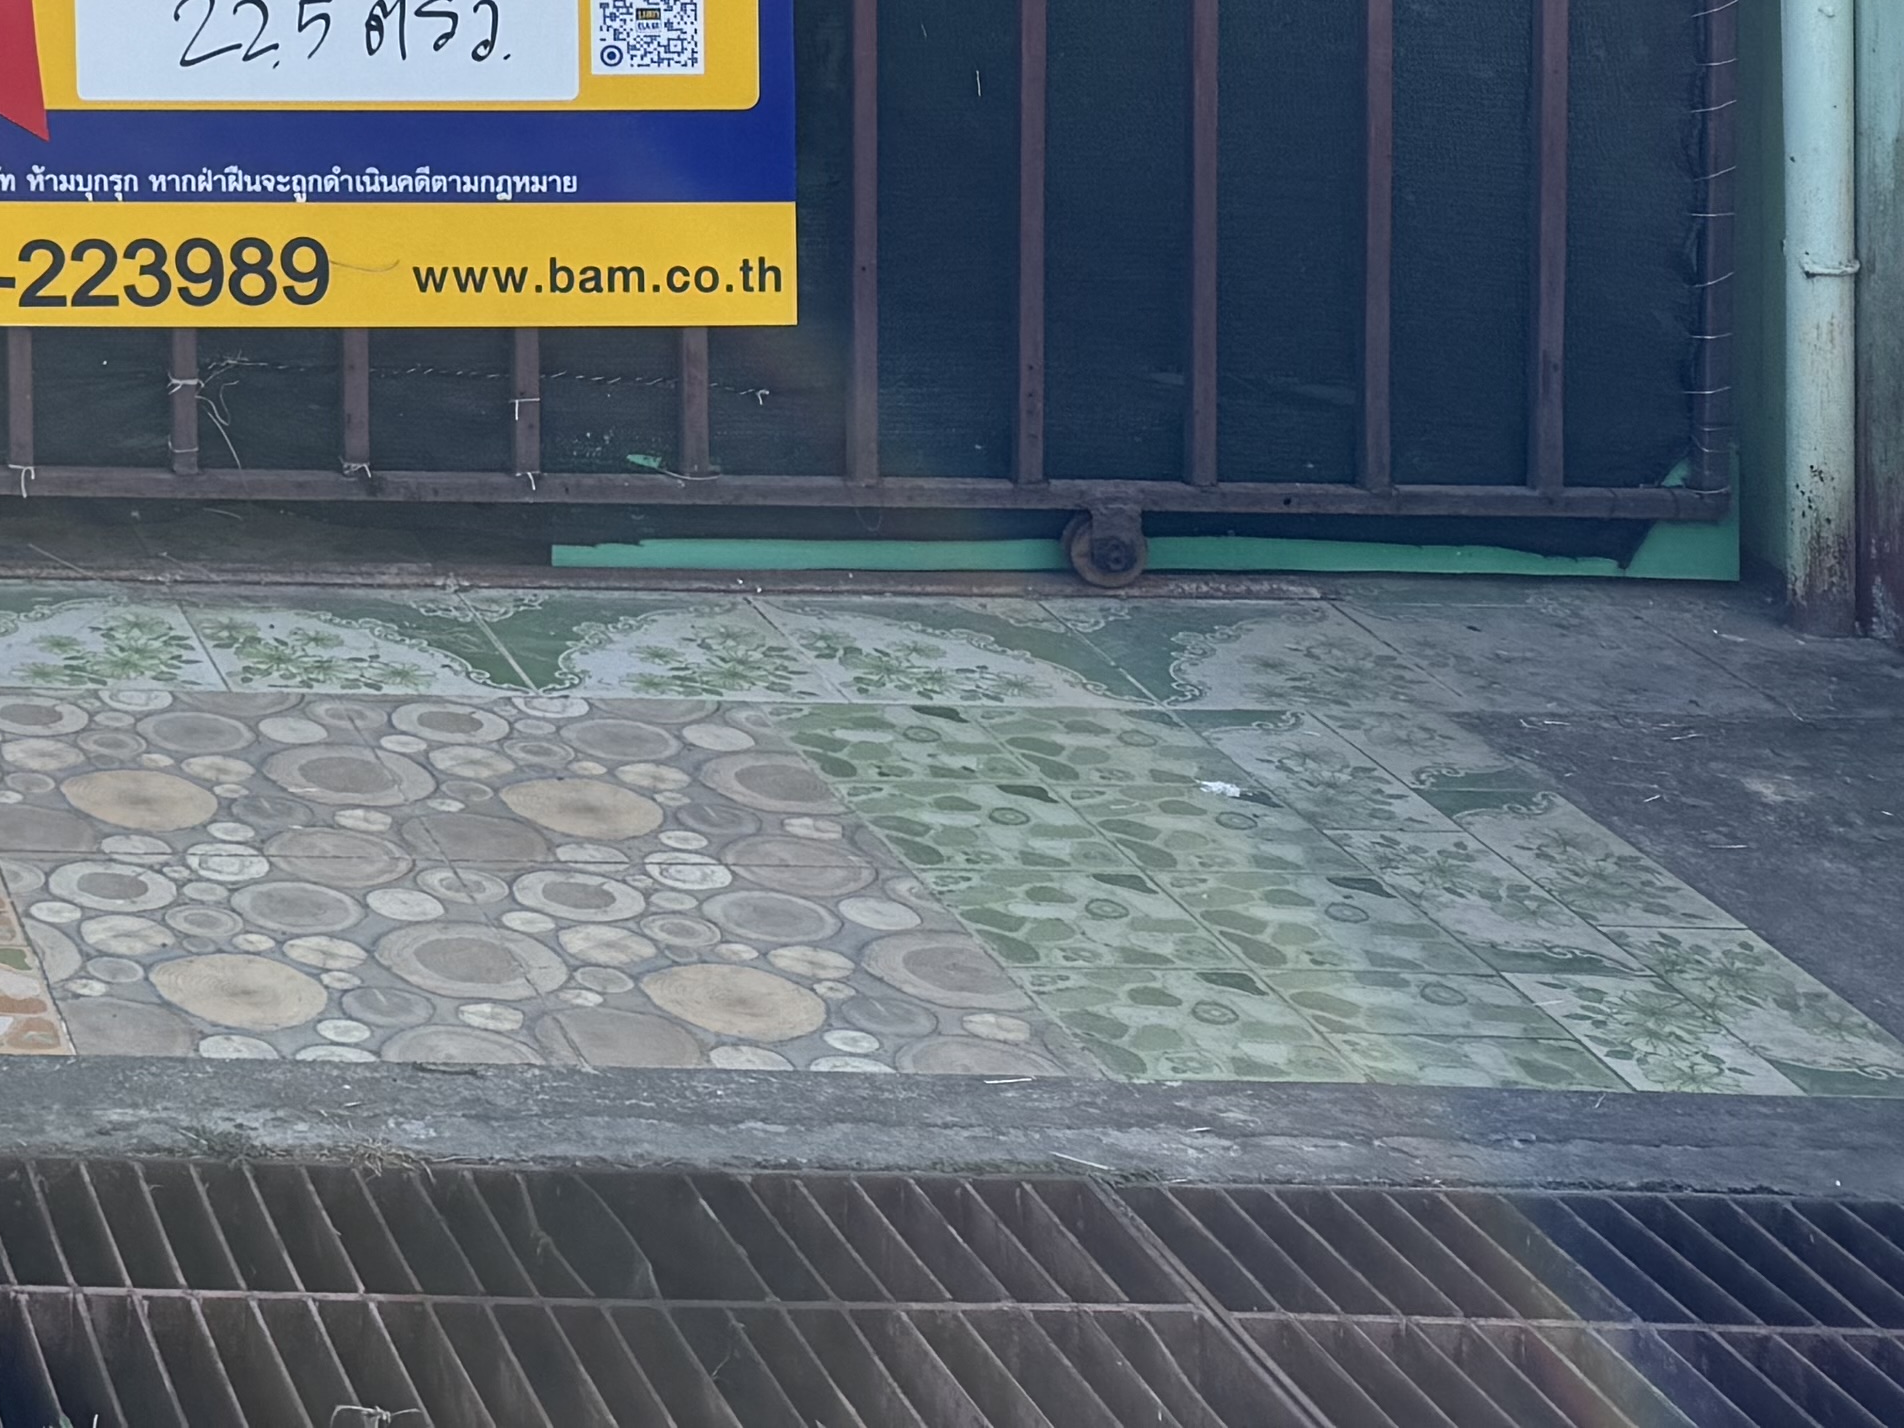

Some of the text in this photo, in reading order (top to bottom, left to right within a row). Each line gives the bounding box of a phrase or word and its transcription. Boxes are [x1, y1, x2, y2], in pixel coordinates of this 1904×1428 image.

[25, 164, 139, 202] ห้ามบุกรุก
[149, 166, 578, 202] หากฝ่าฝืนจะถูกดำเนินคดีตามกฎหมาย
[412, 256, 783, 294] www.bam.co.th
